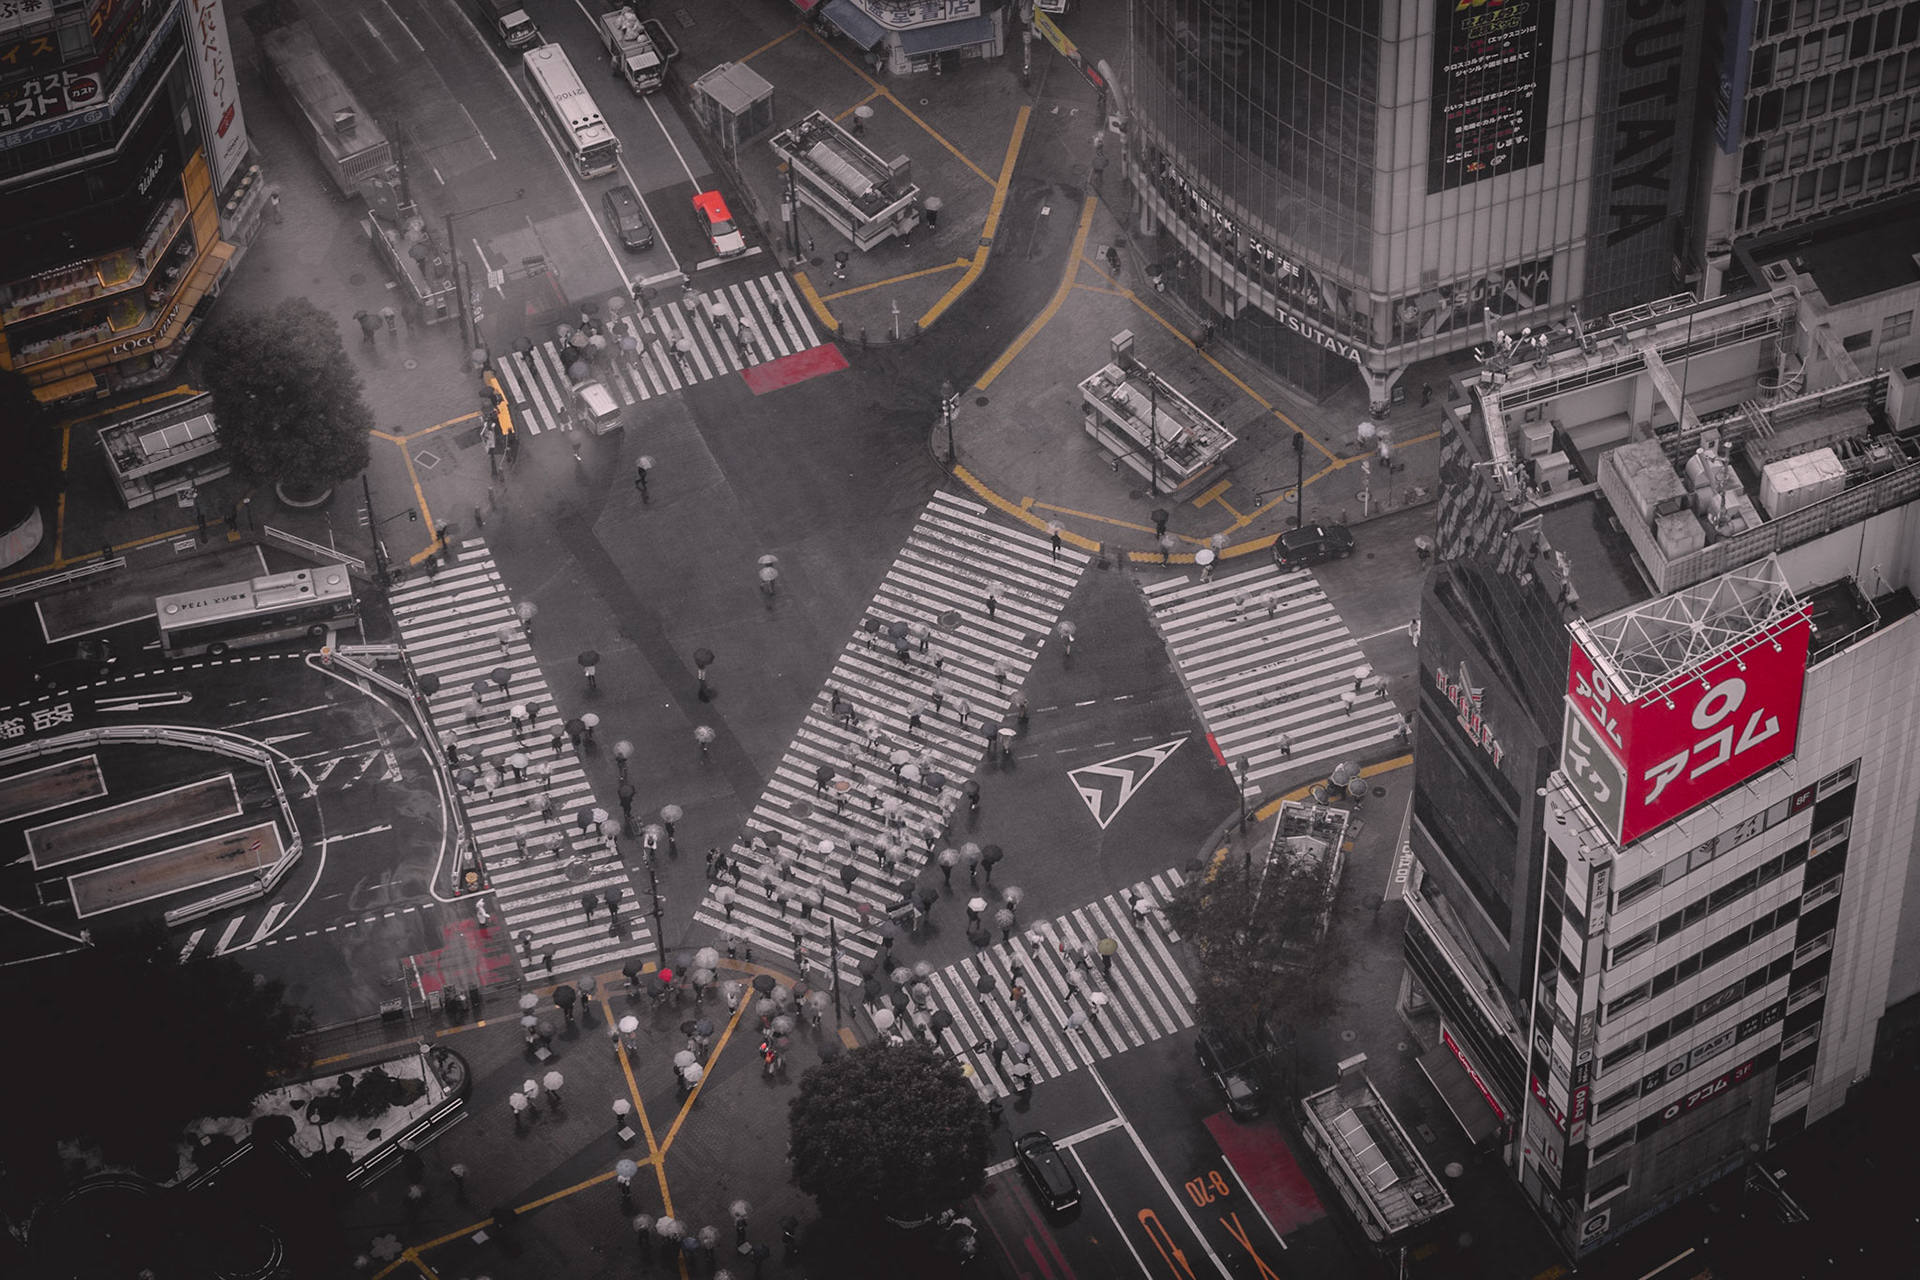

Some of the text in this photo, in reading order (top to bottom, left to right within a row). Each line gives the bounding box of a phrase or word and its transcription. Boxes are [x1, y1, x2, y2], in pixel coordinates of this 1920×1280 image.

[23, 70, 78, 97] ガスト
[72, 86, 95, 98] ガスト
[1606, 0, 1685, 248] UTAYA
[1438, 269, 1550, 310] TSUTAYA
[1276, 307, 1362, 364] TSUTAYA
[180, 599, 209, 611] 1734
[1436, 667, 1505, 770] MAGNET
[1576, 671, 1622, 749] アコム
[1568, 716, 1611, 803] レイク
[1644, 708, 1780, 806] アコム
[1796, 791, 1811, 806] 8F
[1701, 989, 1736, 1014] レイク
[1535, 1081, 1567, 1133] アコム
[1687, 1064, 1752, 1107] アコム 3F
[1184, 1169, 1230, 1209] 8-20
